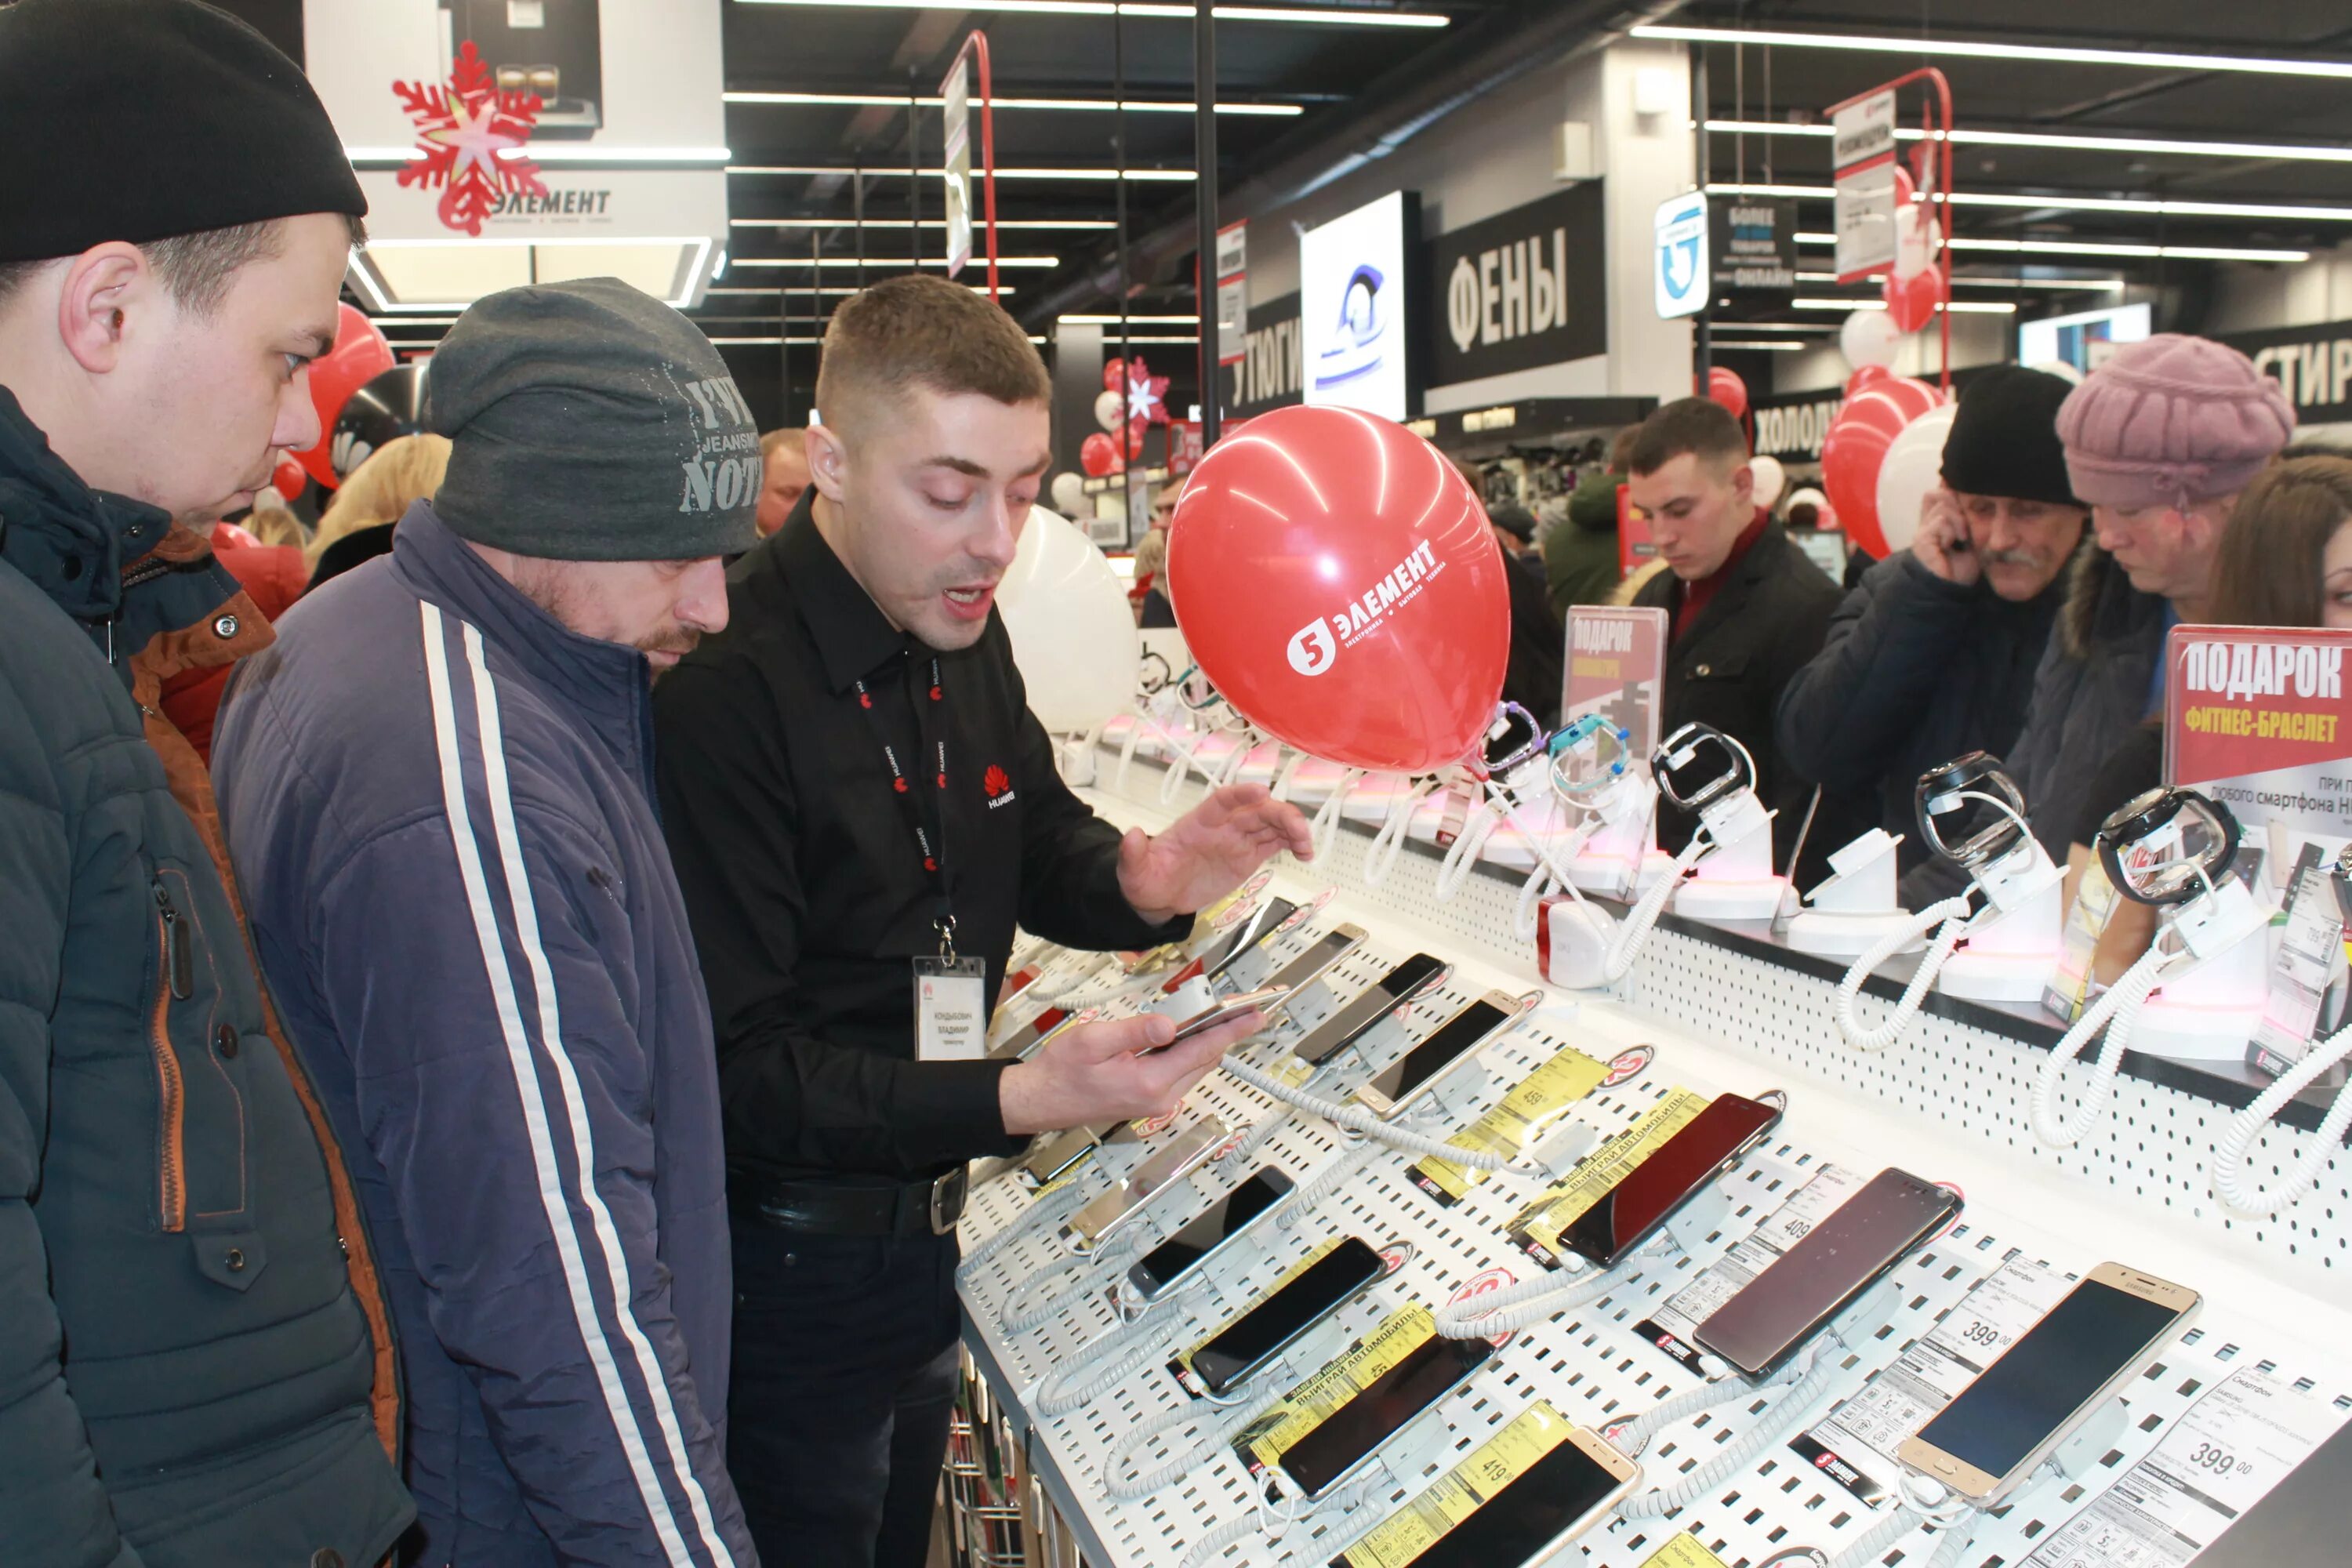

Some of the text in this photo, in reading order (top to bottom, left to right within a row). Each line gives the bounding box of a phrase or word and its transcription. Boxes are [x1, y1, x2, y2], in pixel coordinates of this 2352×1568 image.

[492, 191, 611, 214] ЭЛЕМЕНТ
[1448, 228, 1566, 352] ФЕНЫ
[1332, 539, 1436, 641] ЭЛЕМЕНТ
[1345, 561, 1446, 648] ЭЛЕКТРОНИКА БЫТОВАЯ ТЕХНИКА
[1574, 619, 1633, 655] ПОДАРОК
[2186, 641, 2343, 702] ПОДАРОК
[2185, 706, 2339, 742] ФИТНЕС-БРАСЛЕТ
[884, 746, 902, 777] HUAWEI
[2318, 776, 2343, 792] ПРИ
[989, 790, 1015, 809] HUAWEI
[2210, 786, 2254, 804] любого
[2256, 789, 2334, 813] смартфона
[916, 828, 931, 857] HUAWEI
[1570, 1150, 1618, 1190] ВЫИГРАЙ
[2004, 1265, 2035, 1283] Смартфон
[1290, 1370, 1323, 1397] ЗАВЕДИ
[1297, 1365, 1348, 1406] ВЫИГРАЙ
[2216, 1387, 2243, 1403] SAMSUNG
[2232, 1376, 2273, 1398] Смартфон
